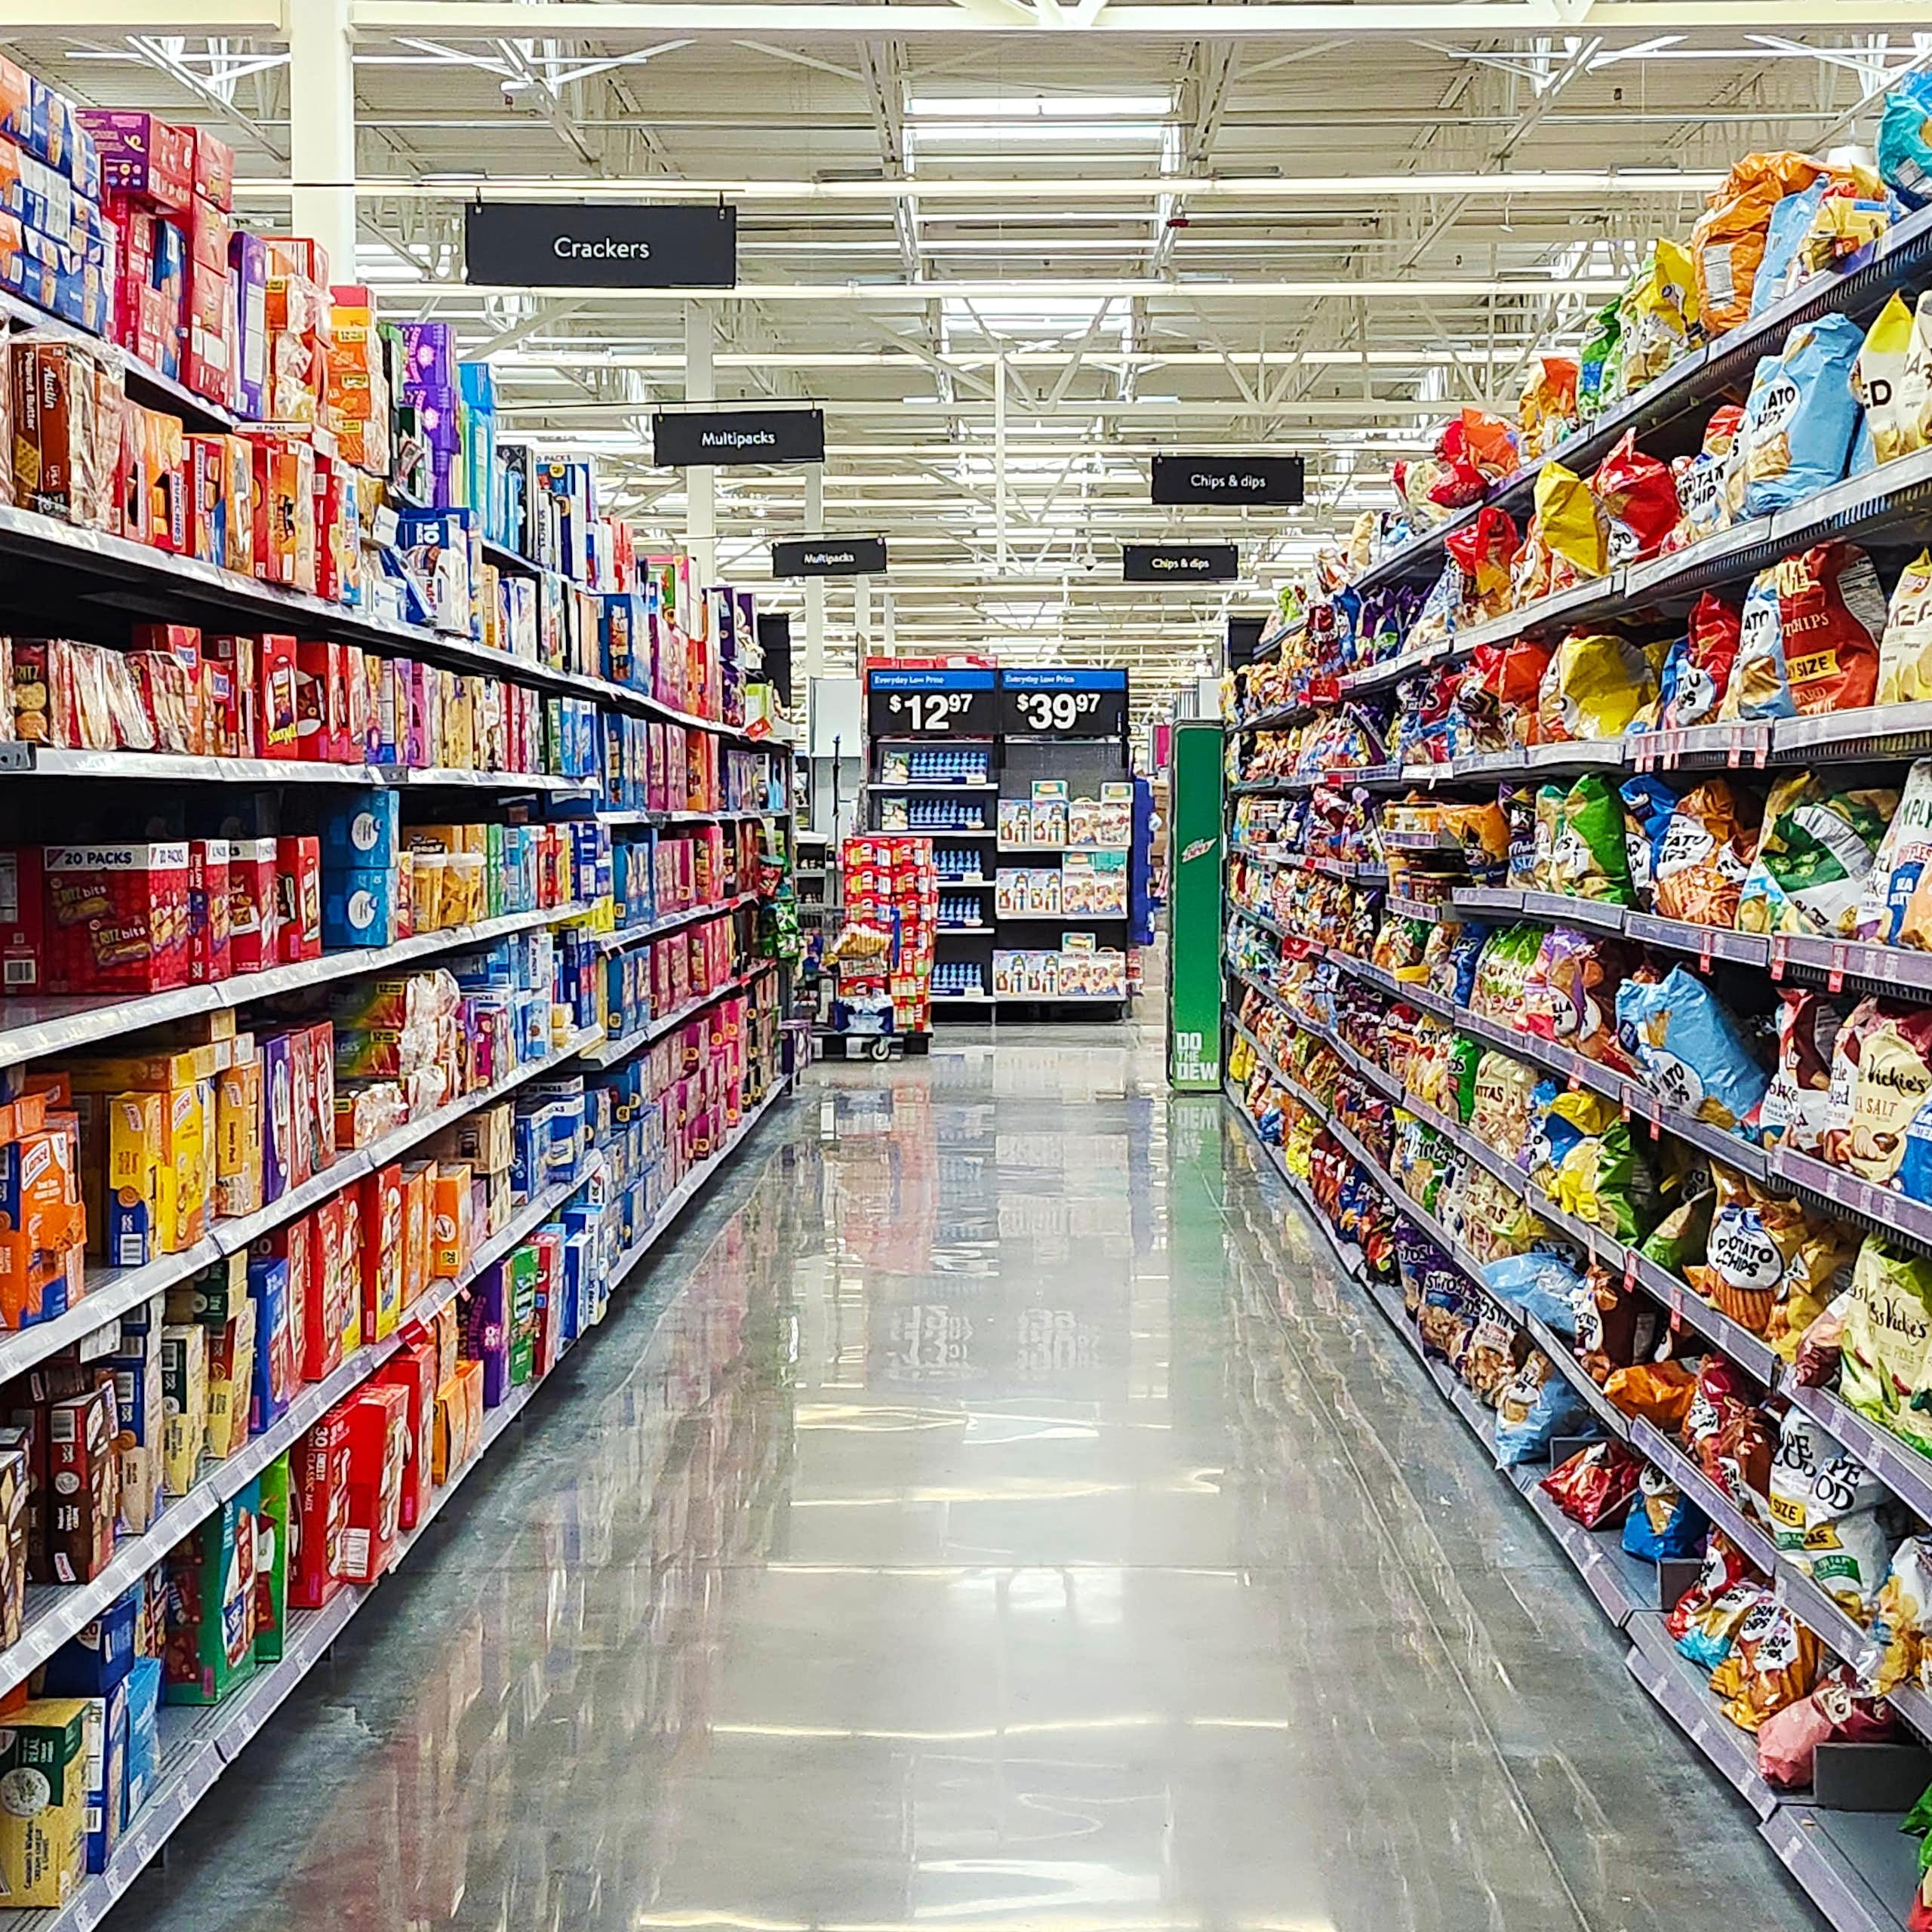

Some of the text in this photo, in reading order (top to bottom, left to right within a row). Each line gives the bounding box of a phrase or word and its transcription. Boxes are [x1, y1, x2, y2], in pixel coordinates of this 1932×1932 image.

[554, 236, 650, 258] Crackers
[24, 352, 35, 430] Peanut Butter
[43, 366, 58, 409] Austin
[702, 431, 775, 449] Multipacks
[1191, 474, 1266, 491] Chips & dips
[423, 521, 440, 544] 10
[1152, 558, 1179, 571] Chips
[15, 664, 38, 681] RITZ
[1798, 655, 1829, 676] SIZE
[875, 675, 908, 685] Everyday
[1004, 674, 1075, 684] Everyday Low Price
[65, 852, 132, 865] 20 PACKS
[82, 884, 106, 898] bits
[121, 925, 146, 939] bits
[1177, 1032, 1202, 1051] DO
[1177, 1050, 1199, 1063] THE
[1176, 1063, 1218, 1080] DEW
[1867, 1054, 1927, 1097] Vickie's
[1867, 1097, 1898, 1118] SALT
[1718, 1235, 1774, 1263] POTATO
[1715, 1251, 1760, 1278] CHIPS
[314, 1426, 328, 1447] 30
[304, 1453, 316, 1512] CLASSIC MIX
